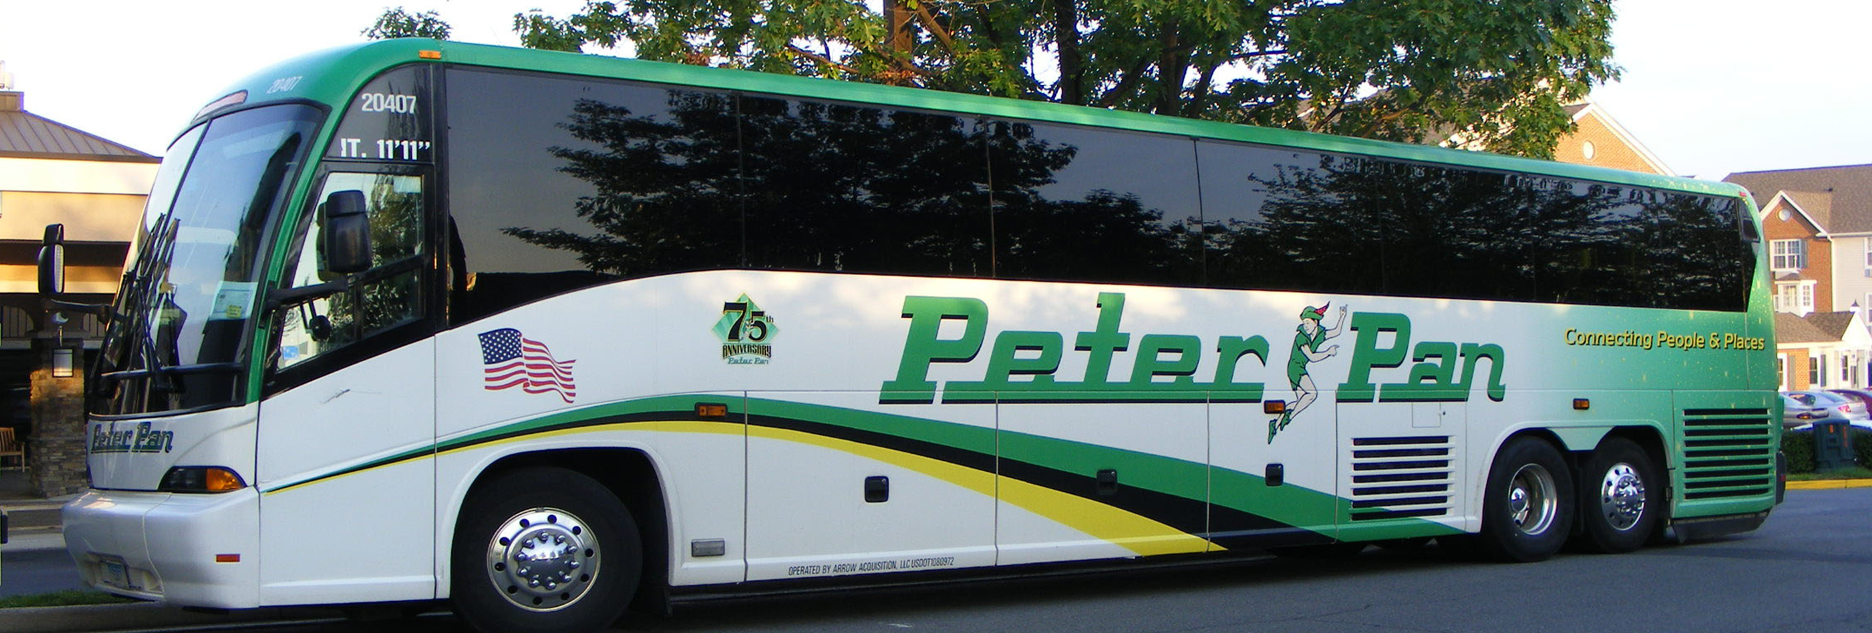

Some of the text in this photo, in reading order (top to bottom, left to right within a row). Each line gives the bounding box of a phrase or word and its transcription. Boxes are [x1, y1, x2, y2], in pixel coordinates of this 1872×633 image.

[266, 76, 303, 94] 20407
[361, 92, 417, 114] 20407
[879, 292, 1506, 404] Peter Pan
[1564, 328, 1765, 351] Connecting People & Places
[722, 344, 772, 359] ANNIVERSARY
[91, 421, 174, 454] Peter Pan
[788, 565, 821, 576] OPERATED
[822, 564, 832, 574] BY
[833, 562, 857, 573] ARROW
[900, 559, 911, 569] LLC
